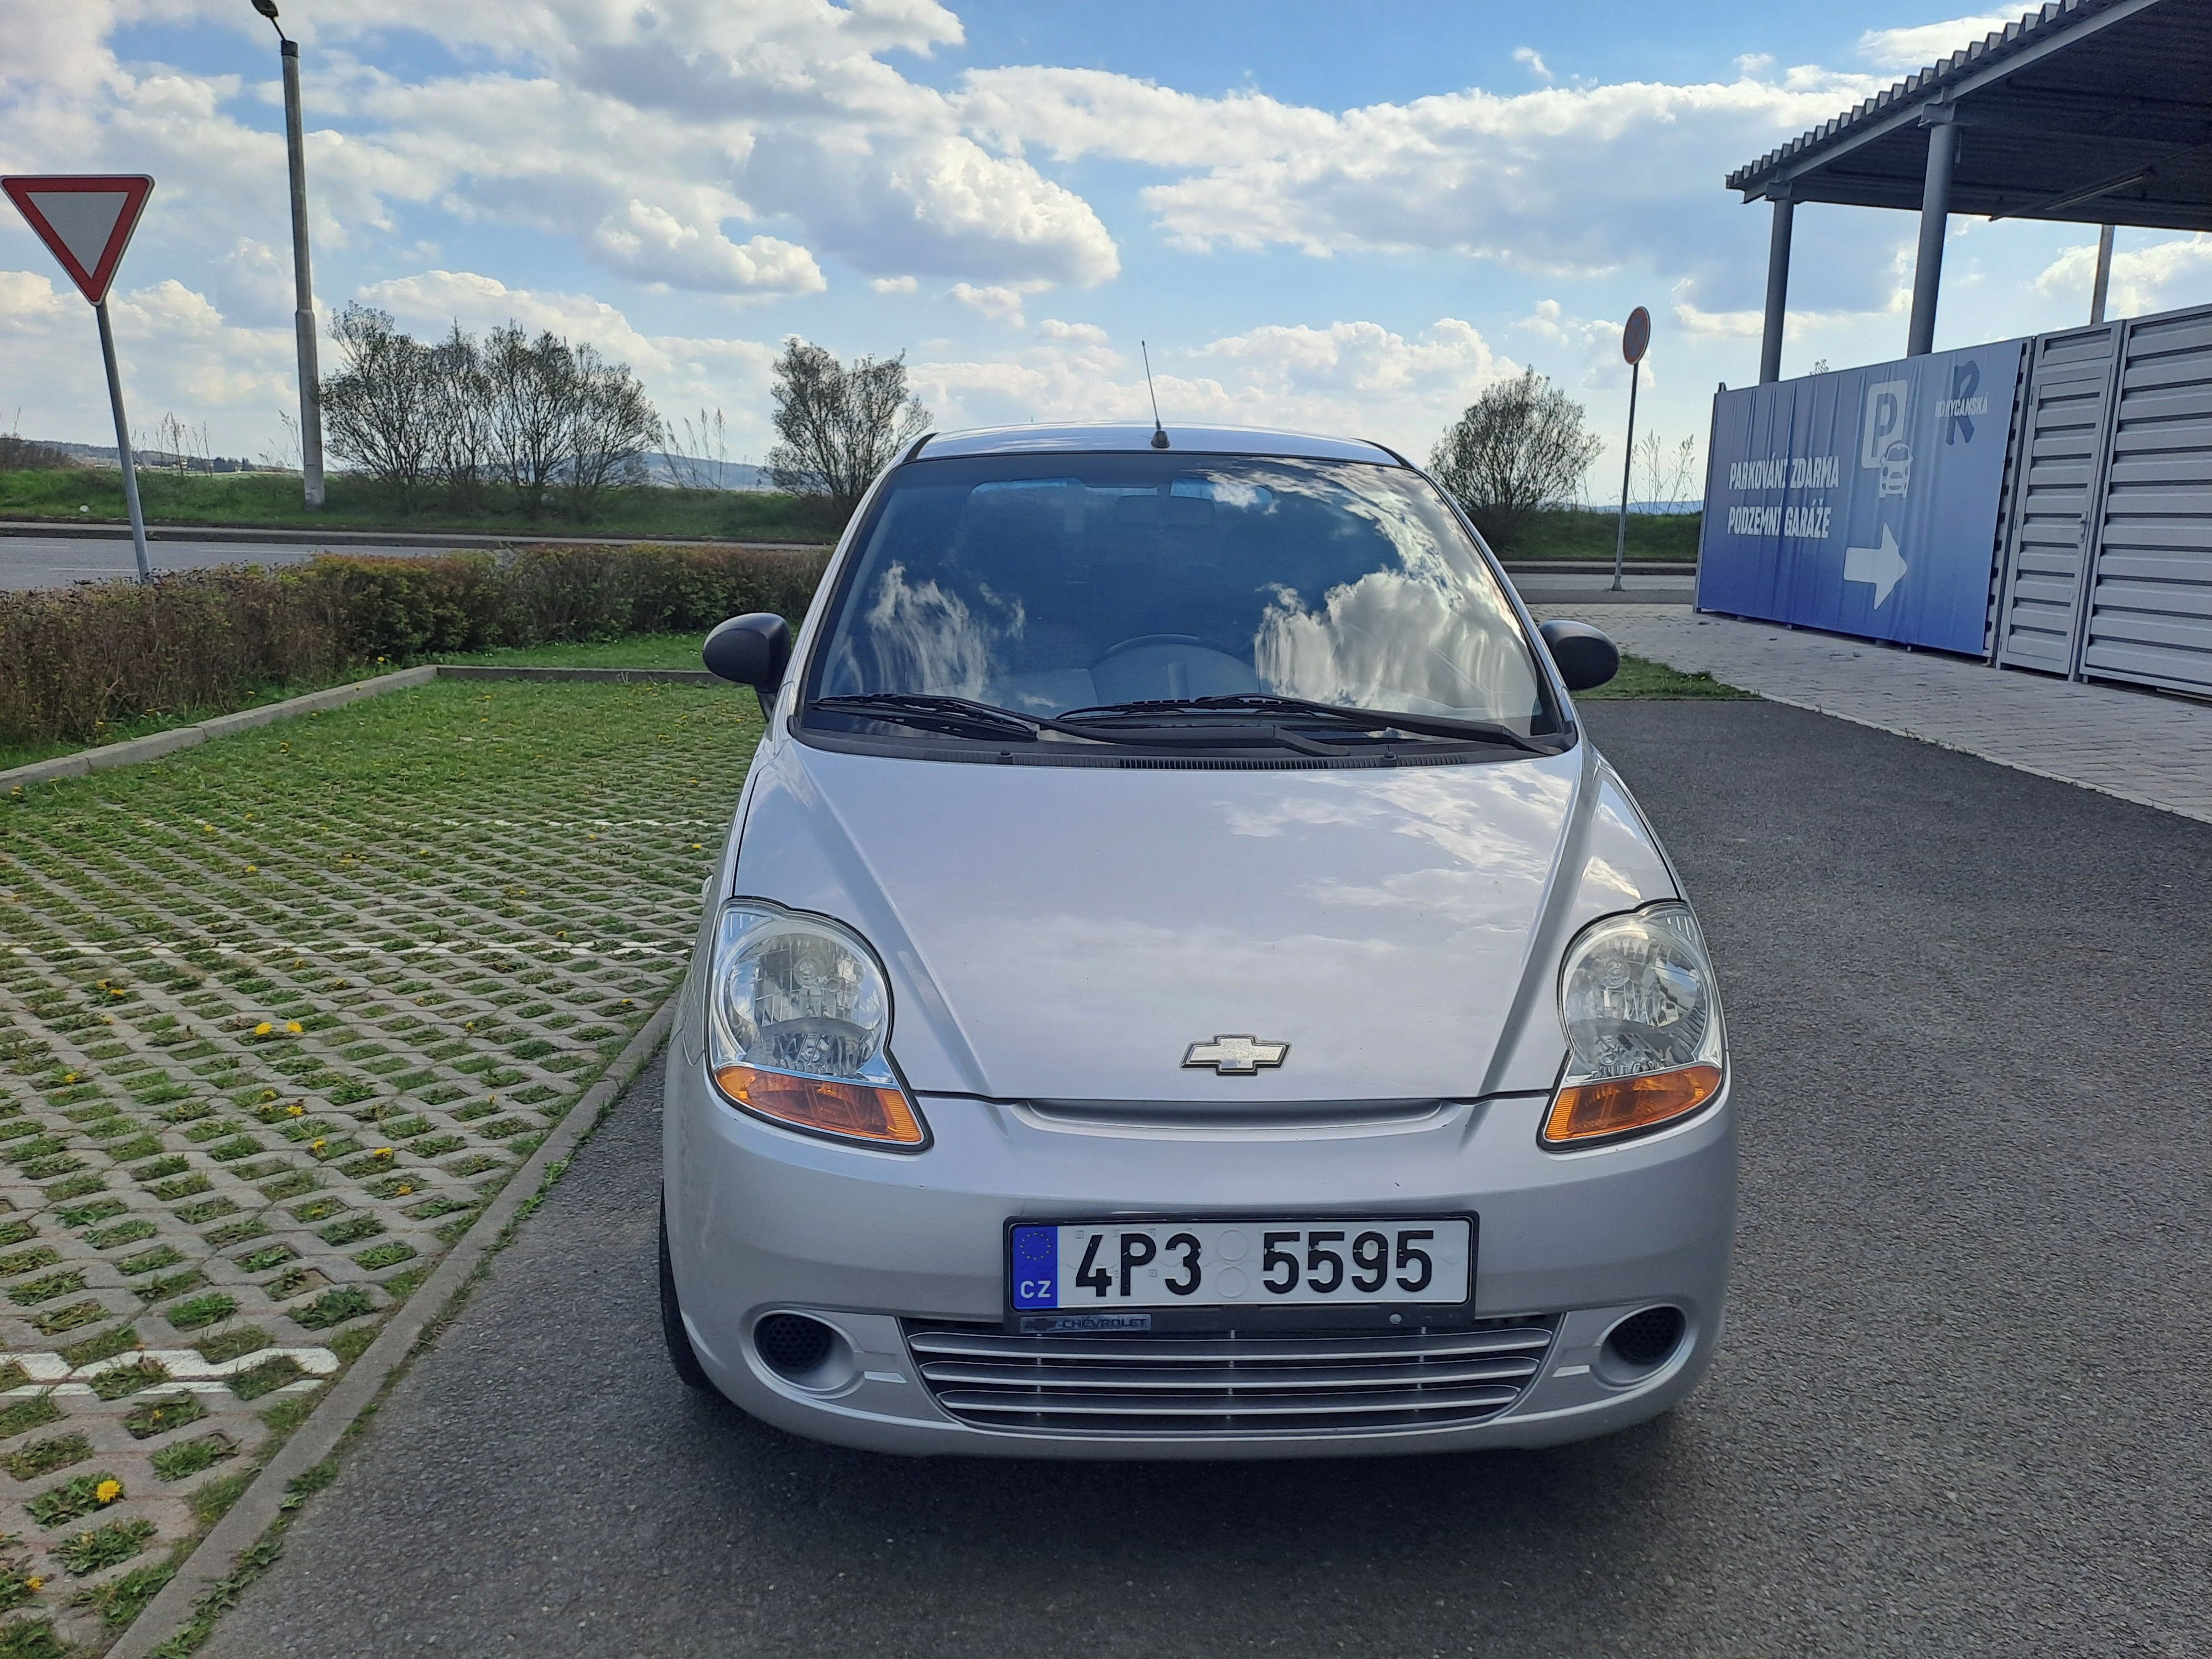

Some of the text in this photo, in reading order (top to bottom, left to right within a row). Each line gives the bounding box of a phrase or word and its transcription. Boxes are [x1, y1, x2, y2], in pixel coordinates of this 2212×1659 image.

[1729, 451, 1839, 491] PARKOVÁNÍ ZDARMA
[1727, 498, 1832, 539] PODZEMNÍ GARÁŽE
[1075, 1229, 1434, 1297] 4P3 5595
[1020, 1280, 1051, 1298] CZ
[1062, 1318, 1147, 1328] CHEVROLET
